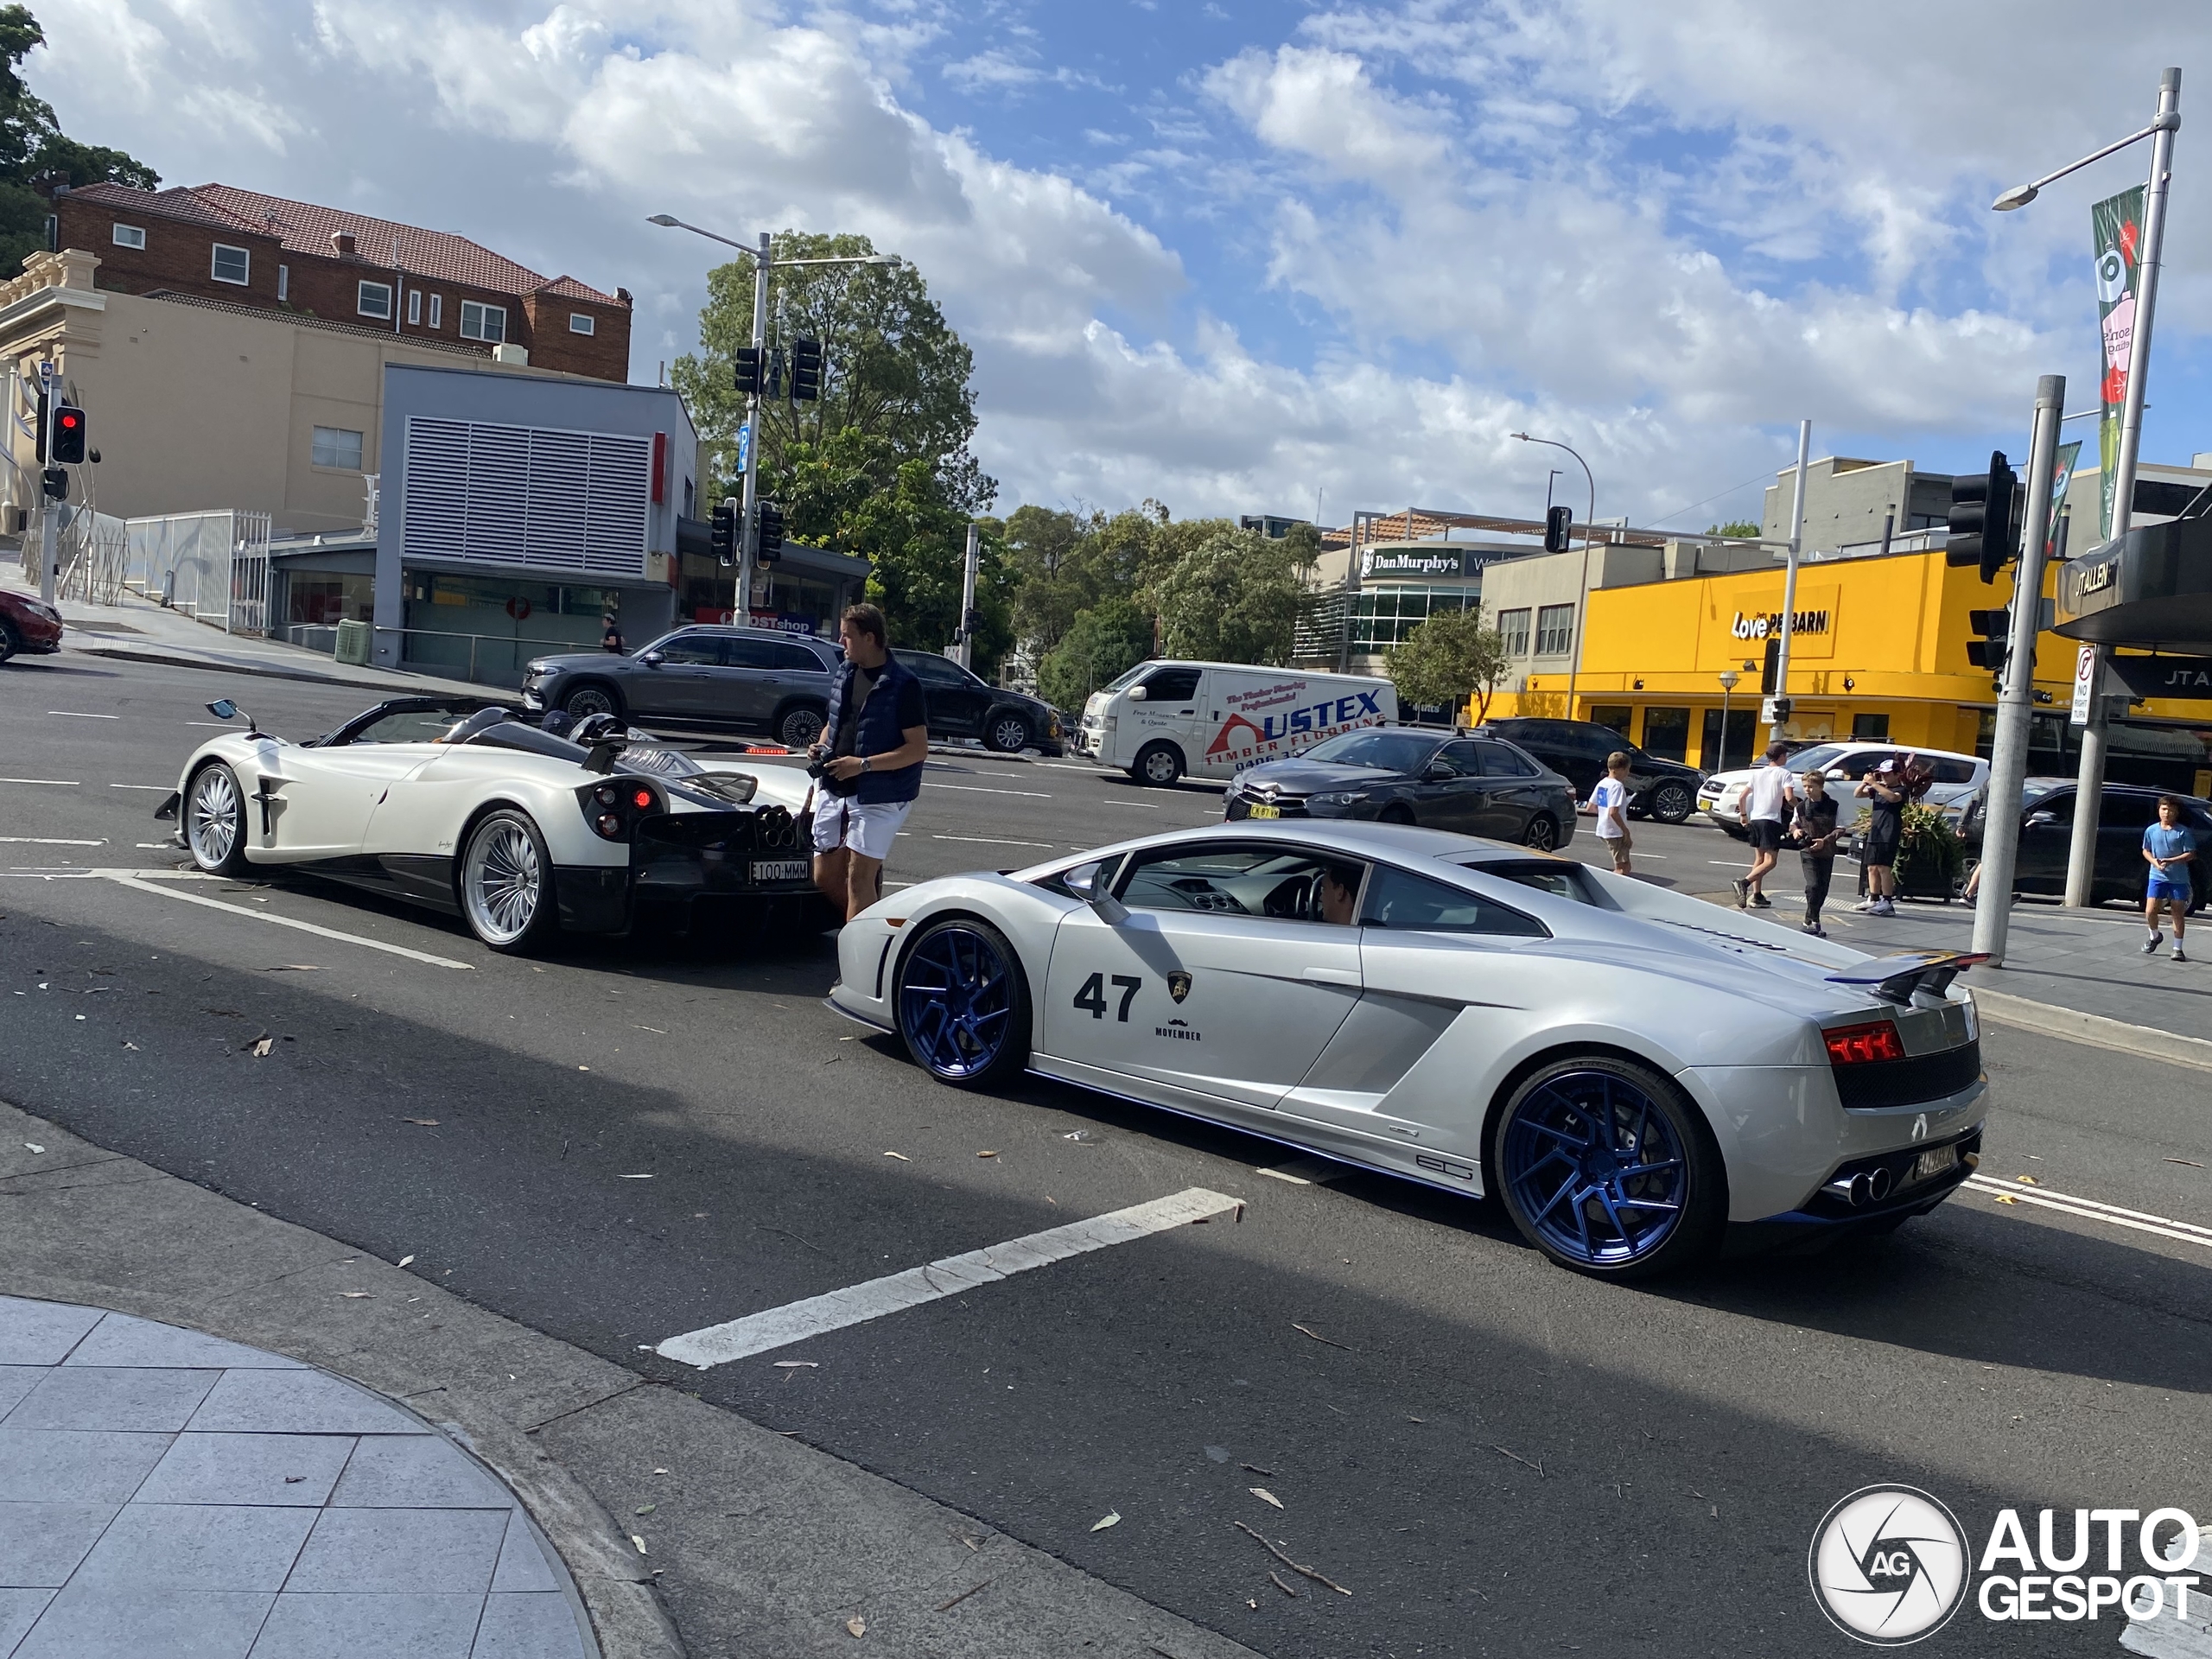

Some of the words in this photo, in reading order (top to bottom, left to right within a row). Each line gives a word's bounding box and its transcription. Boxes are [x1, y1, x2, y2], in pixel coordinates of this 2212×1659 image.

[2083, 562, 2109, 594] ALLEN
[1731, 611, 1768, 639] Love
[1770, 610, 1828, 632] PEBARN
[2165, 670, 2192, 685] JT
[2077, 685, 2088, 696] NO
[2074, 699, 2088, 709] RIGHT
[2074, 710, 2086, 719] TURN
[1205, 741, 1279, 766] TIMBER
[1073, 972, 1141, 1022] 47
[1155, 1027, 1202, 1042] MOVEMBER
